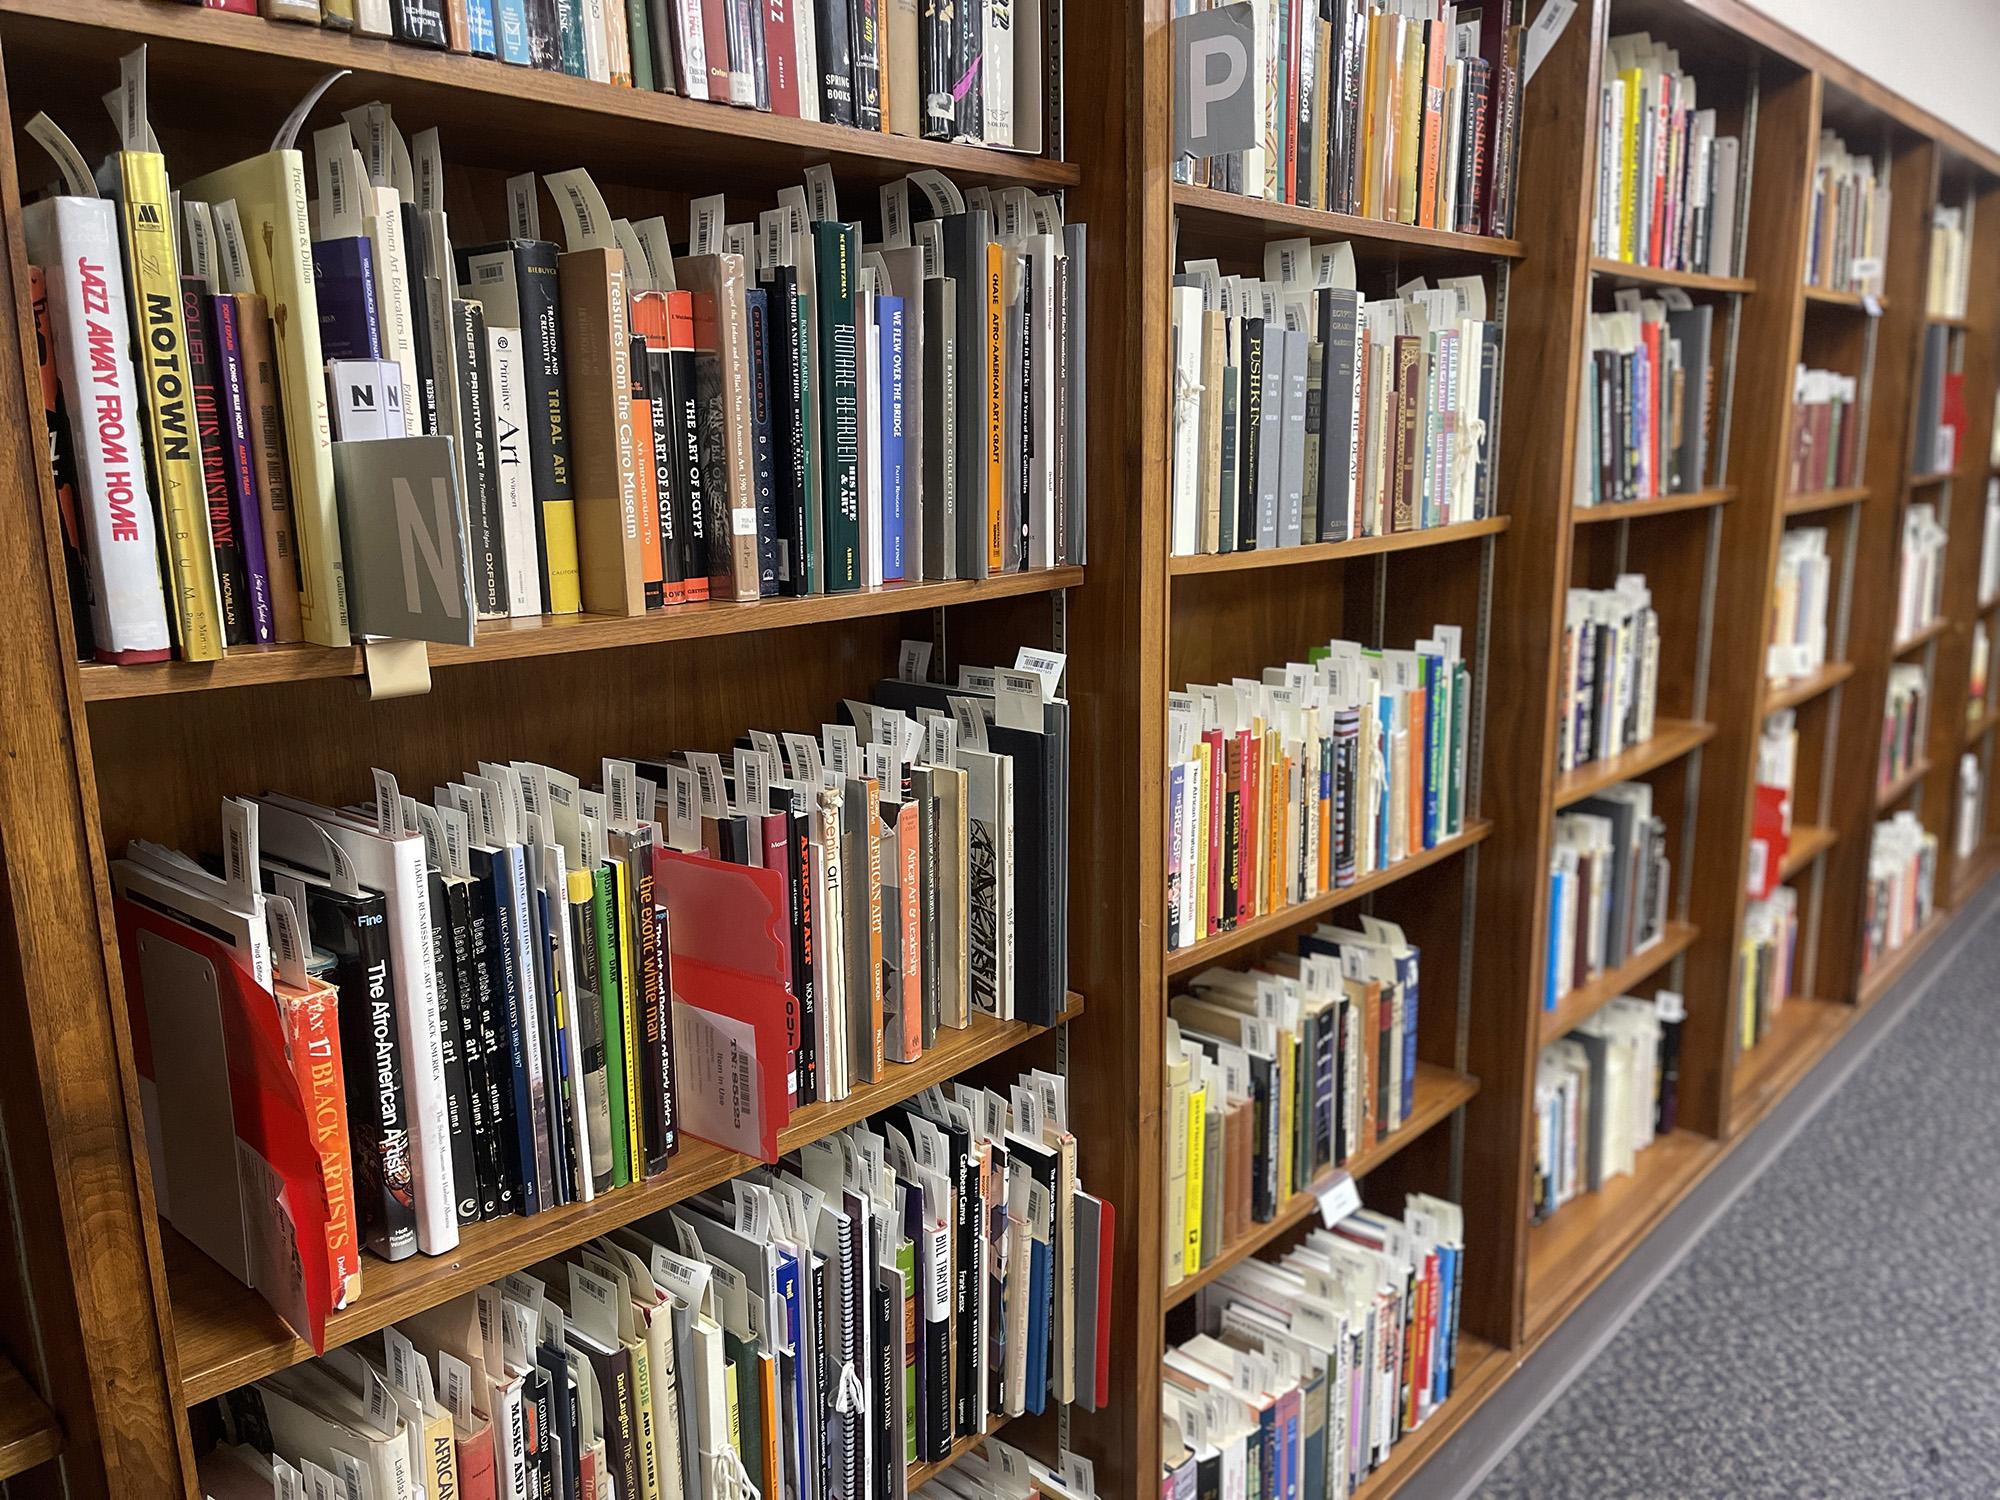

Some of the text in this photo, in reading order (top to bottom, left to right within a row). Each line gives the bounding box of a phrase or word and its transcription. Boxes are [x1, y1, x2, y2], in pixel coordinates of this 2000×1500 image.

[825, 74, 850, 88] SPRING
[827, 88, 852, 102] BOOKS
[1190, 34, 1248, 138] P
[1474, 94, 1489, 177] Pushkin
[302, 250, 311, 284] Dillon
[384, 209, 404, 336] Women Art Educators
[183, 291, 205, 366] COLLIER
[540, 314, 551, 364] CREATIVITY
[546, 304, 557, 352] TRADITION
[788, 282, 798, 347] MEMORY AND
[78, 256, 139, 542] JAZZ AWAY FROM HOME
[146, 293, 190, 460] MOTOWN
[228, 363, 245, 441] SONG OF BILLIE HOLIDAY
[351, 384, 374, 406] N
[386, 385, 398, 407] N
[464, 304, 486, 468] WINGERT PRIMITIVE ART
[610, 269, 636, 539] Treasures from the Cairo Museum
[730, 321, 744, 457] Indian and the Black Man American
[834, 323, 858, 462] ROMARE BEARDEN
[892, 310, 902, 438] WE FLEW OVER THE BRIDGE
[991, 272, 1000, 464] CHASE ART CRAFT
[1250, 338, 1261, 428] PUSHKIN
[1350, 304, 1364, 481] THE BOOK OF THE DEAD
[194, 384, 234, 550] LOUIS ARMSTRONG
[499, 416, 521, 466] Art
[548, 390, 567, 484] TRIBAL ART
[652, 397, 673, 540] THE ART OF EGYPT
[686, 399, 704, 539] THE ART OF EGYPT
[638, 458, 649, 527] Introduction
[758, 436, 772, 558] BASQUIAT
[841, 486, 849, 515] ART
[848, 465, 858, 521] HIS LIFE
[392, 477, 462, 619] N
[486, 552, 496, 605] OXFORD
[222, 573, 235, 626] MACMILLAN
[1174, 804, 1183, 857] BREAST
[1191, 785, 1199, 818] African
[1232, 794, 1241, 844] african
[823, 810, 840, 890] benin art
[1189, 819, 1197, 860] Literature
[358, 914, 383, 928] Fine
[606, 898, 614, 929] NEGRO
[800, 836, 812, 966] AFRICAN ART
[871, 835, 881, 934] AFRICAN ART
[255, 961, 263, 983] Edition
[367, 959, 386, 998] The
[413, 858, 440, 1081] HARLEM ART OF BLACK AMERICA
[454, 926, 468, 962] black
[640, 875, 660, 1042] the exotic white man
[431, 927, 460, 1128] black artists on art volume
[463, 1018, 472, 1032] on
[466, 1038, 480, 1062] art
[473, 918, 502, 1116] black on art volume
[785, 1001, 795, 1046] OUT
[308, 1037, 349, 1250] 17 BLACK ARTISTS
[472, 1092, 483, 1125] volume
[959, 1152, 968, 1226] Caribbean Canvas
[390, 1236, 414, 1248] Winston
[395, 1227, 408, 1236] Holt
[935, 1234, 949, 1306] BILL TRAYLOR
[616, 1372, 629, 1439] Dark Laughter
[637, 1356, 655, 1489] BOOTSIE AND OTHERS
[394, 1458, 406, 1497] Ladislas
[511, 1400, 524, 1494] MASKS AND
[538, 1397, 552, 1496] ROBINSON THE
